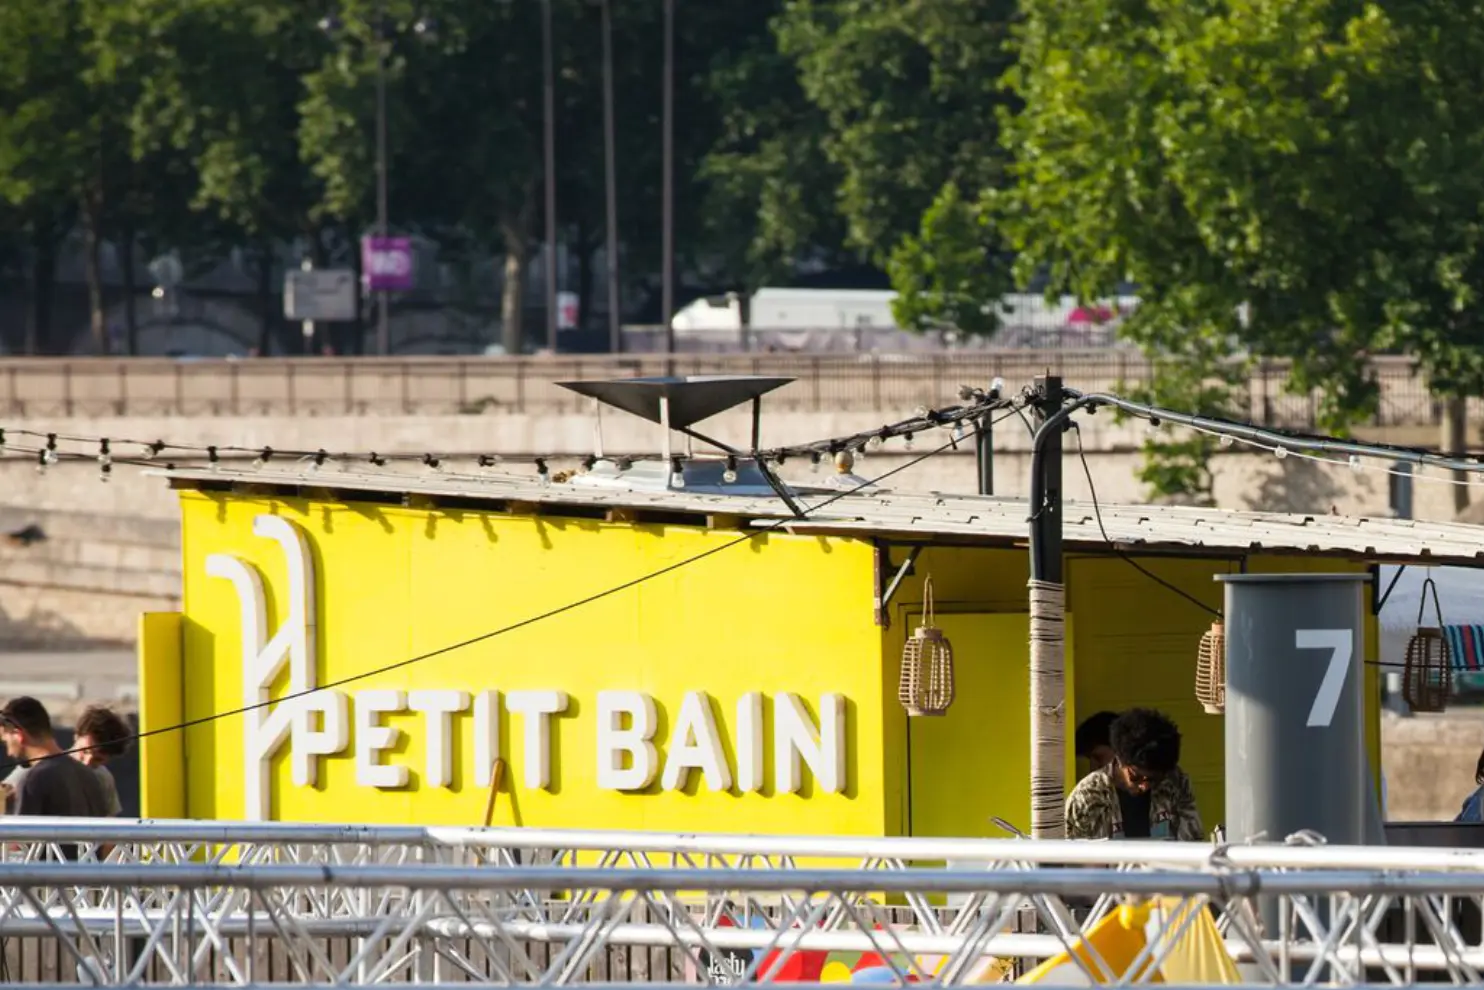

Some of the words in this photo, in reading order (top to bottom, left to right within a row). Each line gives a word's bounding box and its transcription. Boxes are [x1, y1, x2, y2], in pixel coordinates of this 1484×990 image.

[1295, 628, 1354, 728] 7
[292, 689, 569, 790] PETIT
[599, 690, 848, 796] BAIN
